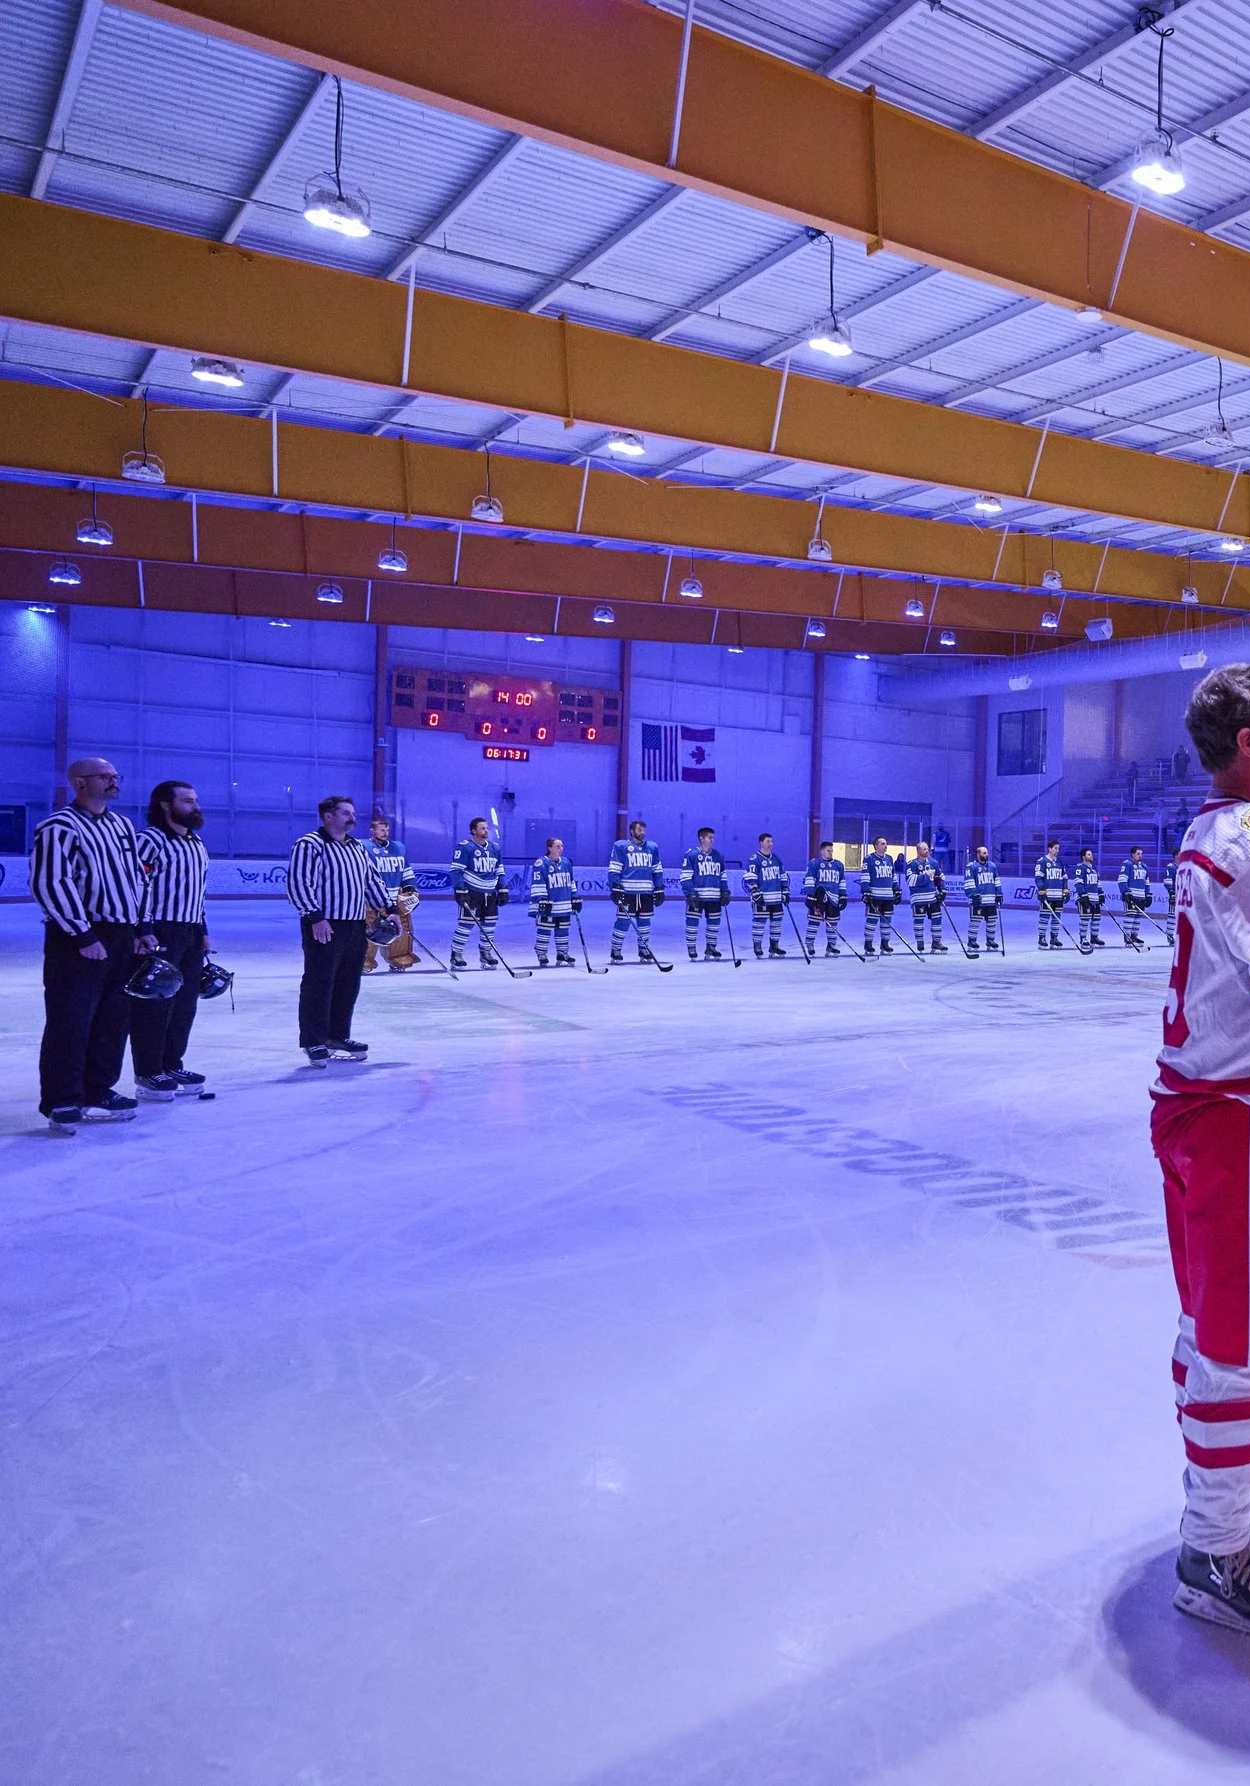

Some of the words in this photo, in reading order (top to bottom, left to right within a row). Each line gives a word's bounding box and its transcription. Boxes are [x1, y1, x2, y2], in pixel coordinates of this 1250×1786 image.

[429, 714, 439, 726] 0
[482, 722, 492, 735] 0
[537, 727, 547, 740] 0
[587, 728, 596, 740] 0
[486, 748, 527, 760] 06:17:31
[415, 872, 448, 888] Ford
[533, 871, 541, 881] 15
